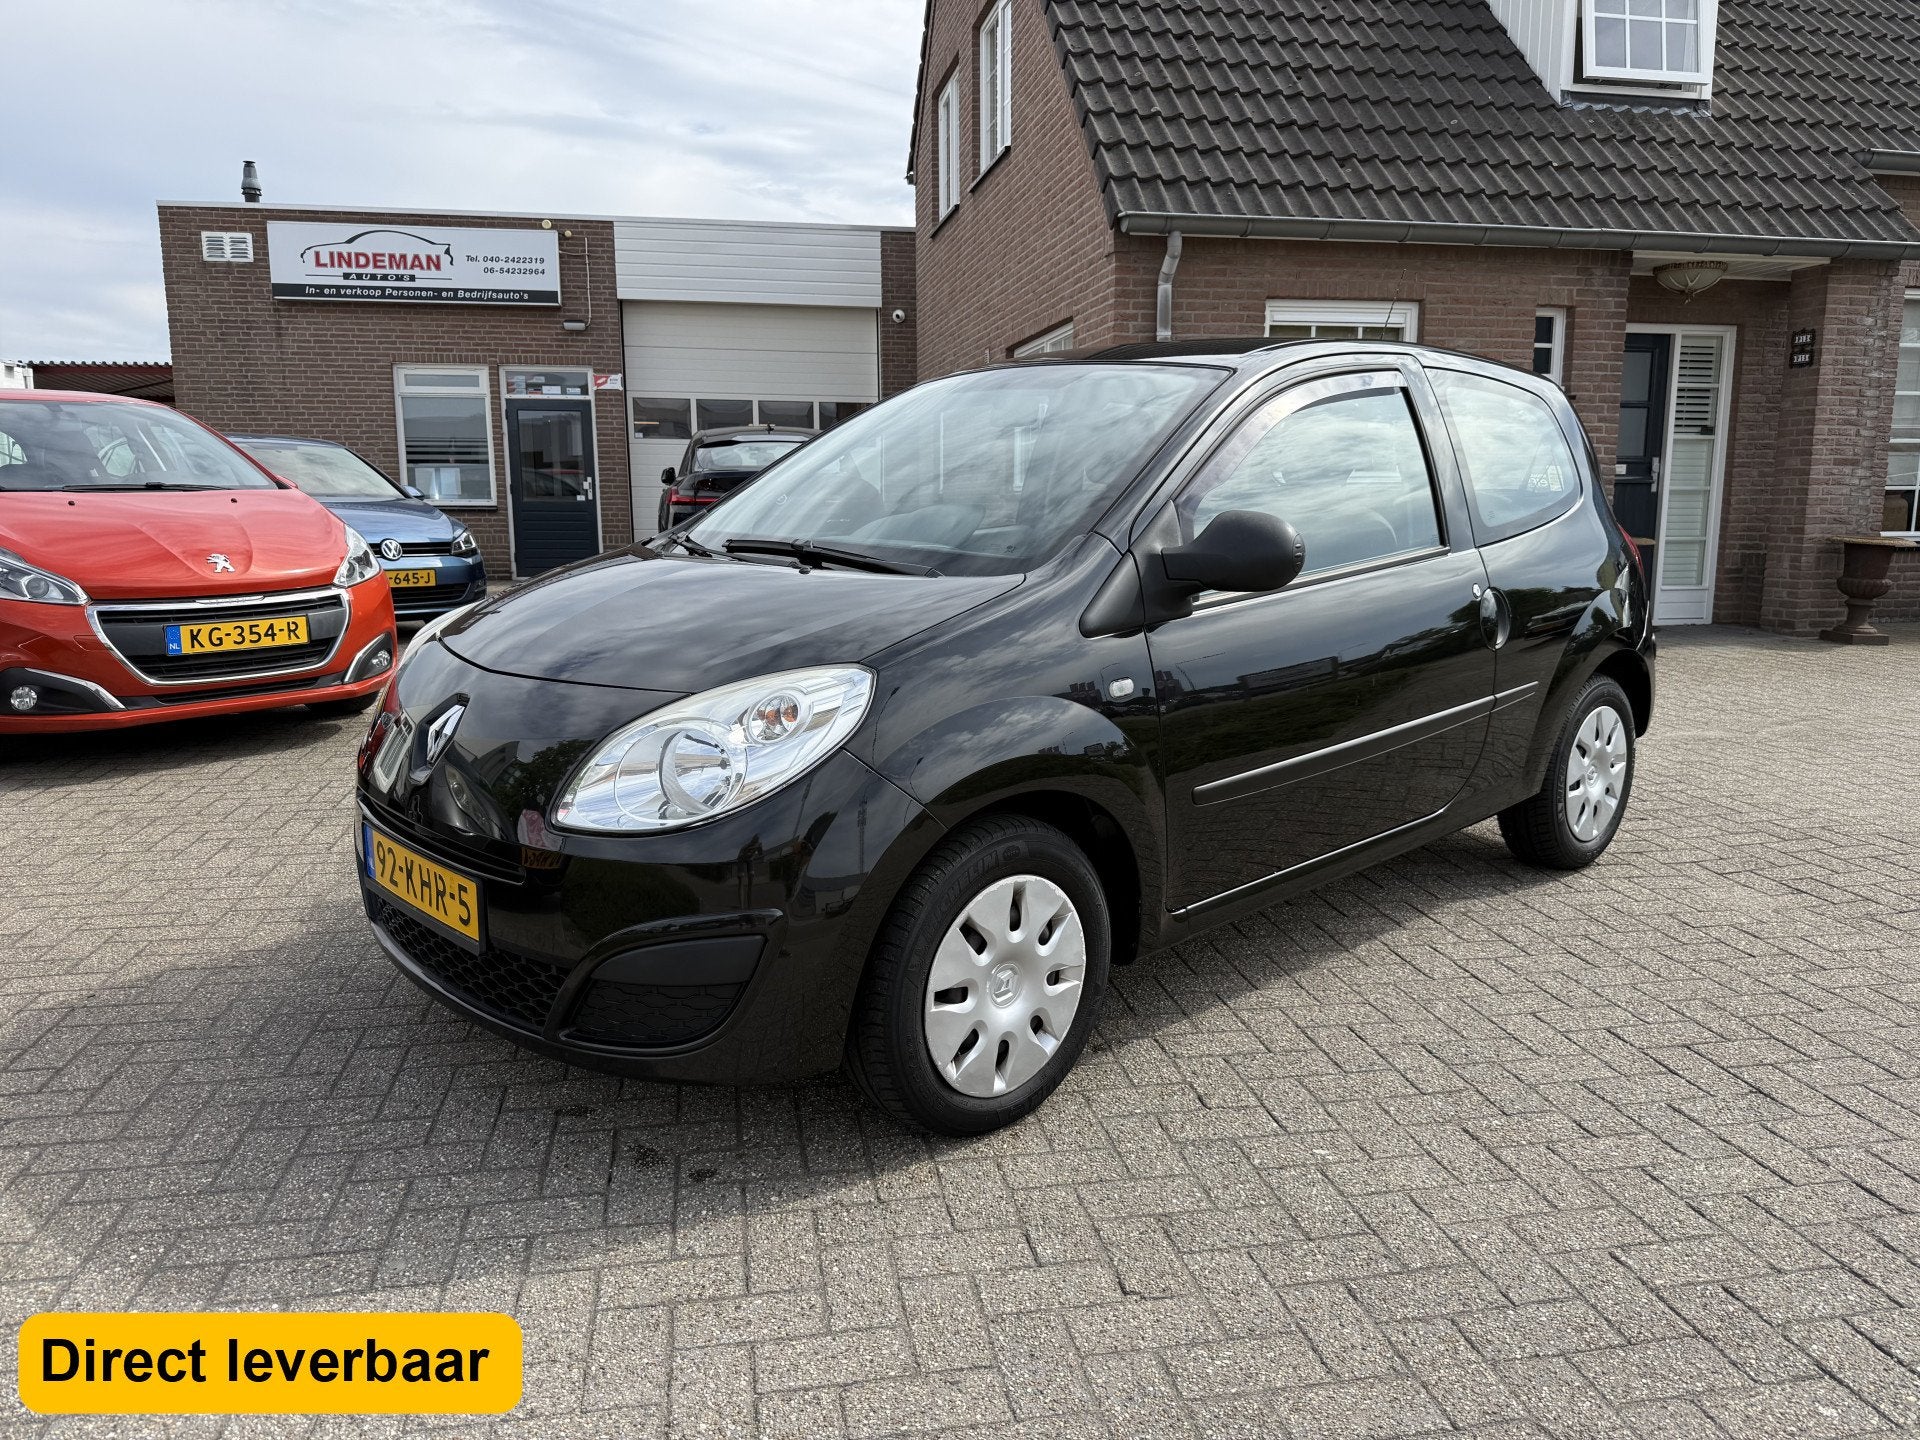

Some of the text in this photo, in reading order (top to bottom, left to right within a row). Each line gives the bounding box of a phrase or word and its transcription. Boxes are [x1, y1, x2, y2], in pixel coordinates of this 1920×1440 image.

[314, 250, 442, 271] LINDEMAN
[466, 255, 545, 264] Tel. 040-2422319
[348, 273, 411, 281] AUTO'S
[483, 266, 546, 275] 06-54232964
[305, 286, 529, 300] In- en verkoop Personen- en Bedrijfsauto's
[189, 620, 300, 648] KG-354-R
[376, 840, 471, 926] 92-KHR-5
